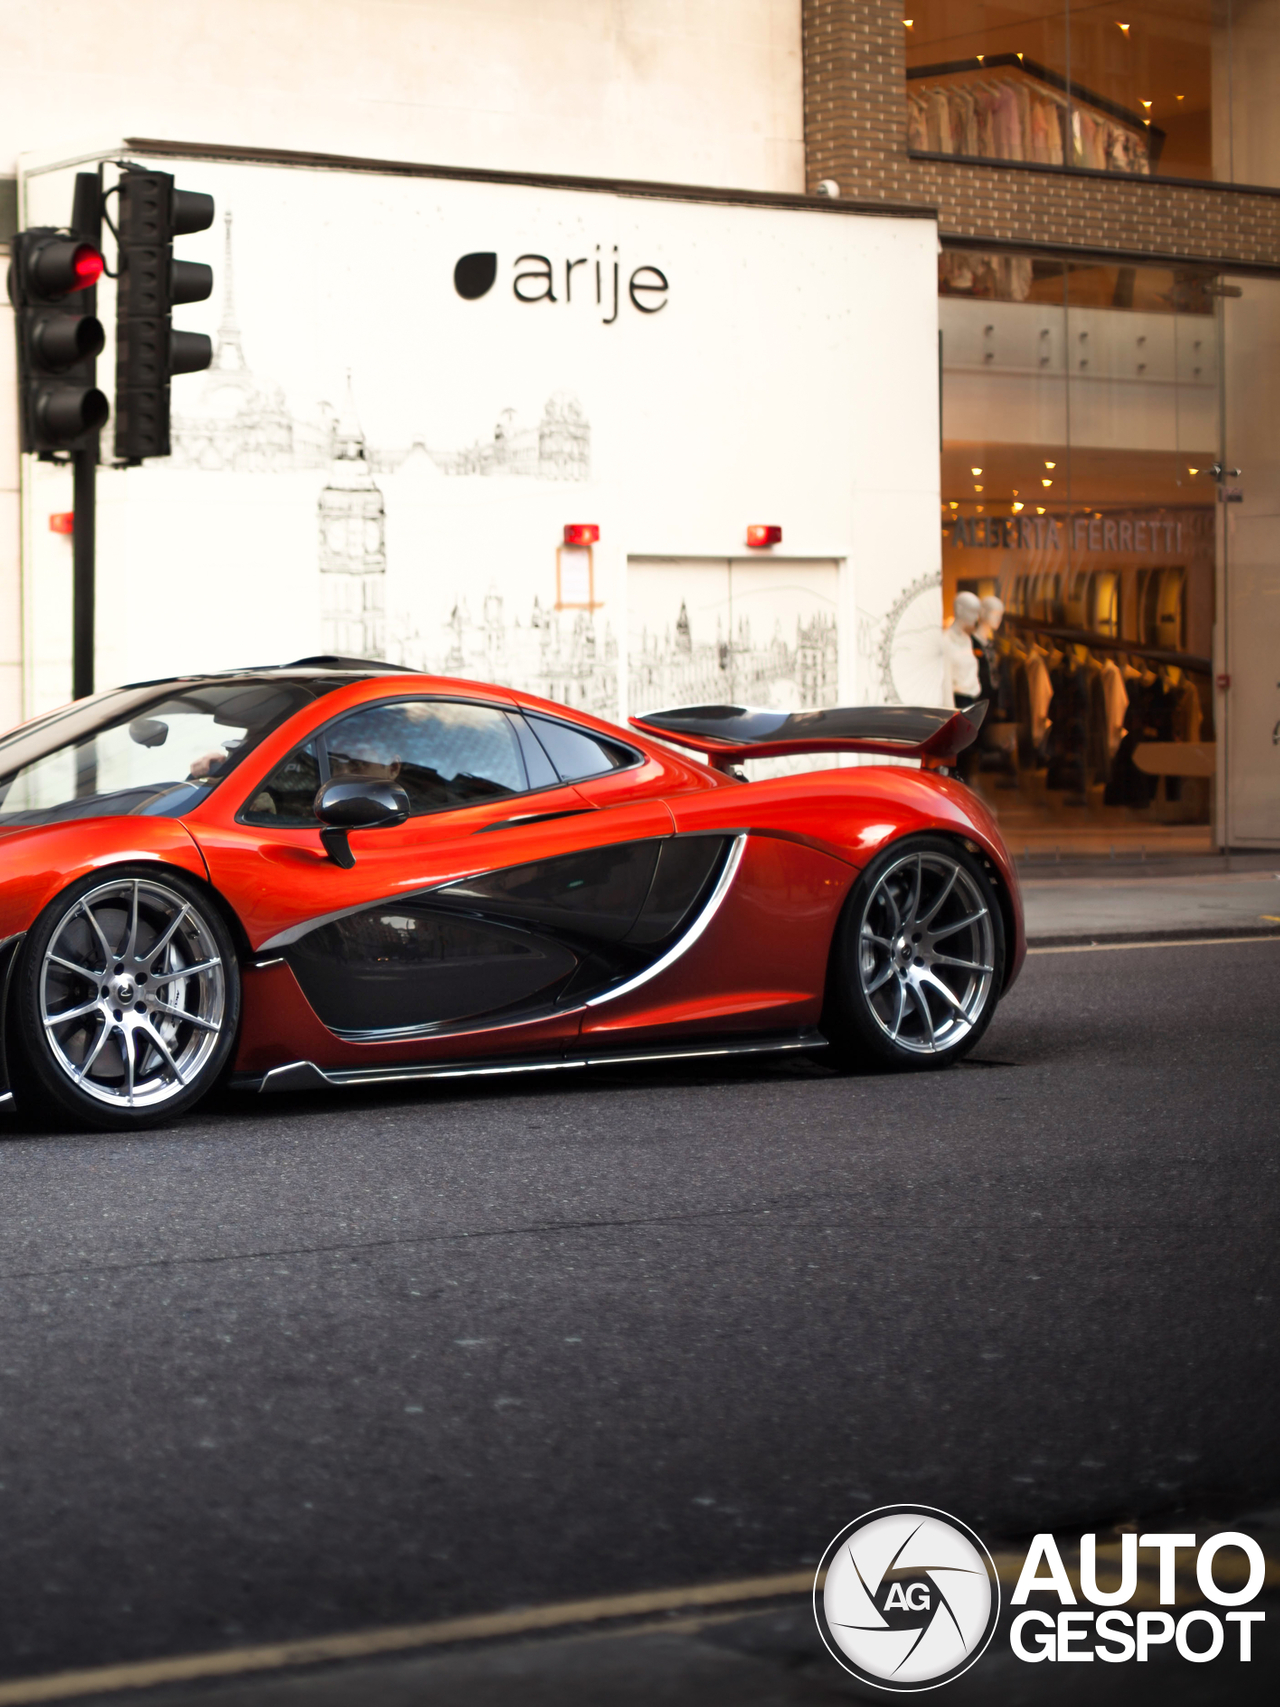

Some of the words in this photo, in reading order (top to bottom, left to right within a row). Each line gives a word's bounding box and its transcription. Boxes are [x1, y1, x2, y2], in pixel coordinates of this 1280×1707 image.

[513, 243, 669, 324] arije
[952, 516, 1060, 550] ALBERTA
[1070, 518, 1183, 552] FERRETTI
